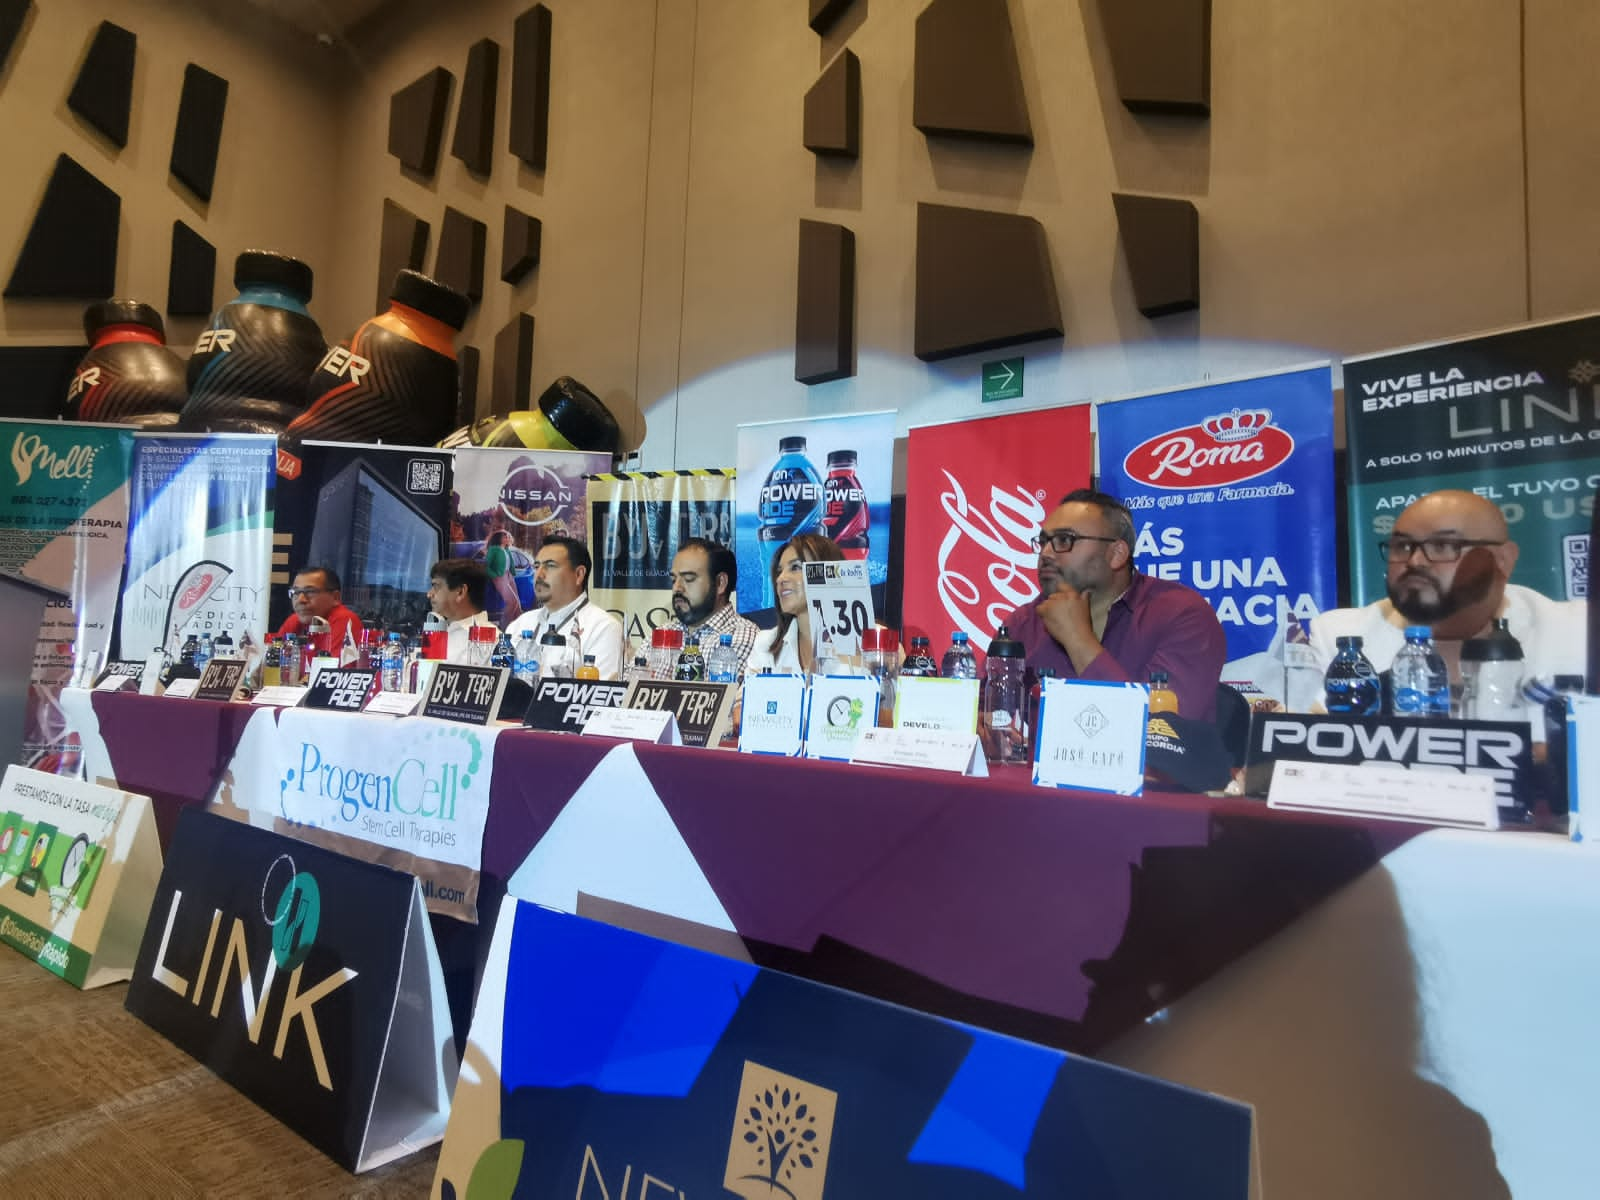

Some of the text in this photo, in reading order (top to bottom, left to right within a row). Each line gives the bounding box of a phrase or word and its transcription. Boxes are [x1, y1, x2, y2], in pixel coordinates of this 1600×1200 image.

[1361, 367, 1465, 396] VIVE LA
[1361, 371, 1545, 413] EXPERIENCIA
[1148, 436, 1265, 481] Roma
[1366, 458, 1377, 469] A
[1380, 453, 1423, 467] SOLO
[1426, 450, 1444, 461] 10
[1447, 439, 1526, 459] MINUTOS
[1529, 435, 1555, 449] DE
[1559, 431, 1585, 443] LA
[498, 488, 572, 504] NISSAN
[760, 482, 823, 503] POWER
[825, 488, 867, 502] OWER
[1123, 494, 1155, 511] Más
[1157, 494, 1184, 511] que
[1187, 492, 1215, 505] una
[1472, 486, 1504, 499] EL
[1507, 477, 1580, 497] TUYO
[1131, 521, 1184, 558] ÁS
[1135, 556, 1288, 590] UE UNA
[1214, 593, 1321, 627] ACIA
[315, 671, 374, 691] POWER
[328, 689, 364, 708] ADE
[537, 682, 628, 708] POWER
[562, 703, 596, 726] AD
[1261, 719, 1525, 770] POWER
[296, 741, 459, 823] ProgenCell
[384, 820, 406, 839] Cell
[151, 889, 361, 1092] LINK
